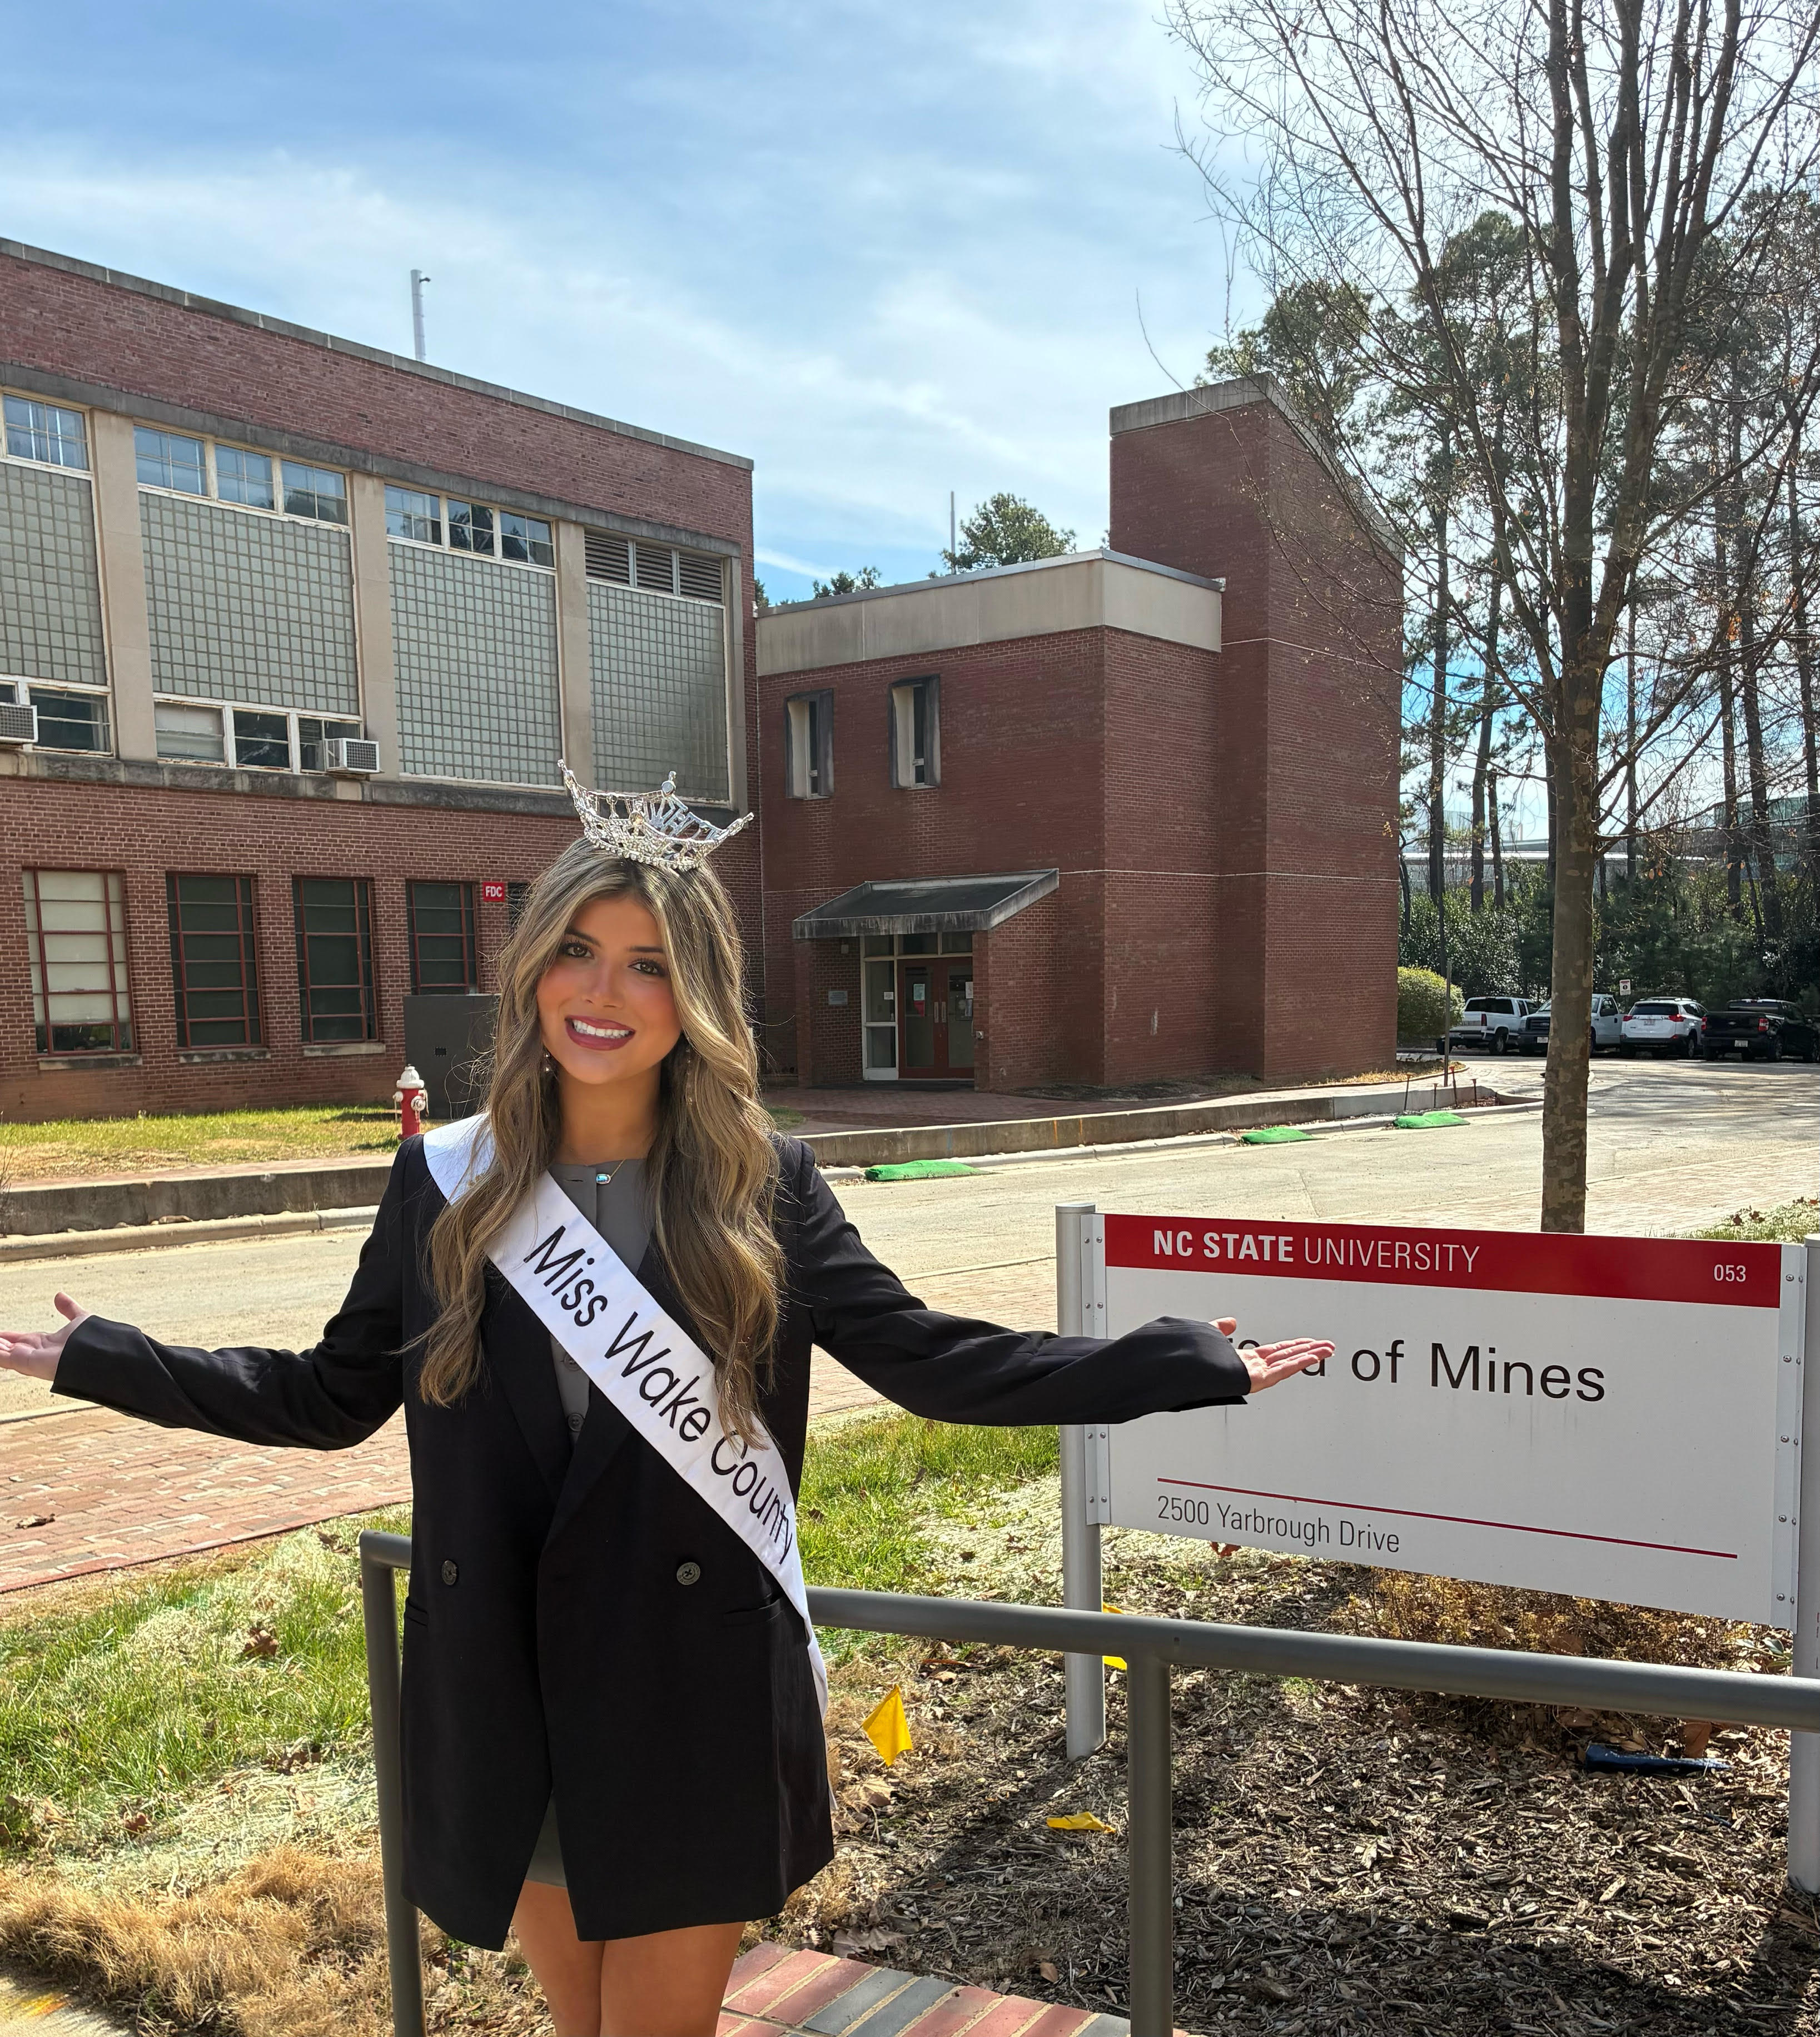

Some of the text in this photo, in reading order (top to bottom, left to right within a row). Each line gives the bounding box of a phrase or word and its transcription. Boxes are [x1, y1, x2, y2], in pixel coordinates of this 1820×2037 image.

[485, 886, 503, 897] FDC
[1153, 1230, 1480, 1273] NC STATE UNIVERSITY
[1714, 1264, 1746, 1282] 053
[523, 1225, 793, 1564] Miss Wake County
[1351, 1339, 1405, 1383] of
[1431, 1342, 1605, 1402] Mines
[1157, 1495, 1400, 1553] 2500 Yarbrough Drive
